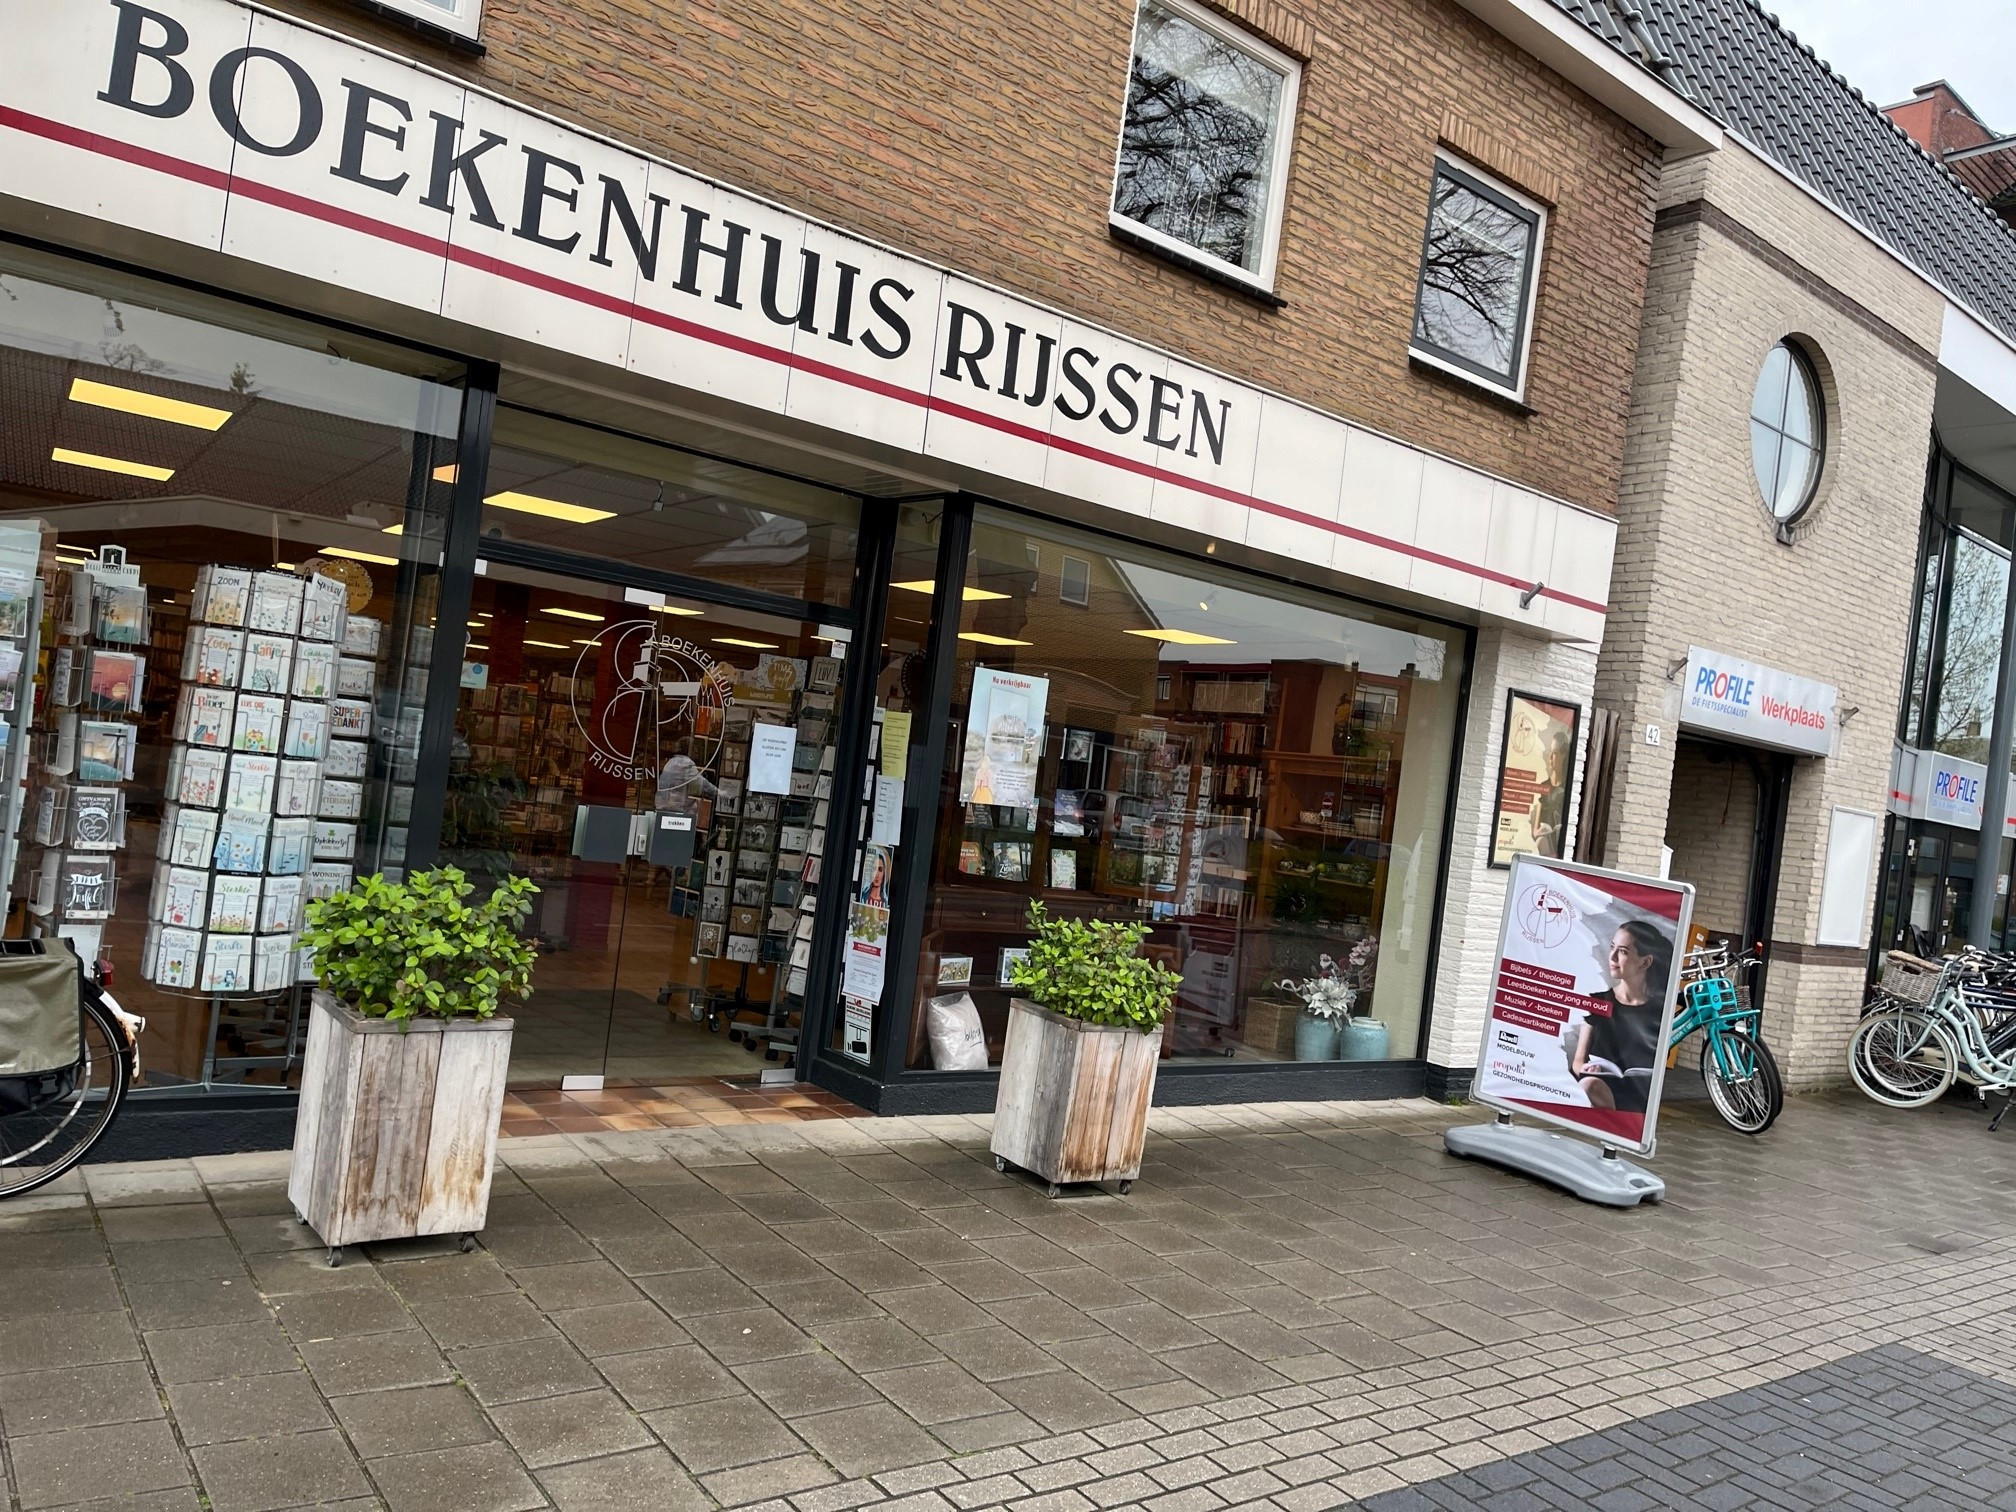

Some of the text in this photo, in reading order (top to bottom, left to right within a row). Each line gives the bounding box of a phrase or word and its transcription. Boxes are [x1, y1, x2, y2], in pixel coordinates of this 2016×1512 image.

[97, 0, 1231, 466] BOEKENHUIS RIJSSEN
[217, 576, 240, 586] ZOON
[661, 634, 735, 707] BOEKENHUIS
[1692, 696, 1748, 718] DE FIETSSPECIALIST
[1695, 666, 1826, 730] PROFILE Werkplaats
[333, 705, 361, 719] SUPER
[331, 718, 365, 729] EDANKT
[1647, 726, 1659, 743] 42
[588, 751, 656, 781] RIJSSEN
[1935, 771, 1978, 803] PROFILE
[221, 882, 252, 894] Sterkte
[1548, 889, 1577, 919] BOEKENHUIS
[1521, 930, 1545, 944] RIJSSEN
[1510, 963, 1532, 976] Bijbels
[1539, 971, 1572, 986] theologie
[1504, 995, 1527, 1008] Muziek
[1534, 1003, 1563, 1017] -boeken
[1507, 978, 1608, 1012] Leesboeken voor jong en oud
[1502, 1010, 1556, 1032] Cadeauartikelen
[1497, 1043, 1536, 1059] MODELBOUW
[1492, 1070, 1571, 1099] GEZONDHEIDSPRODUCTEN
